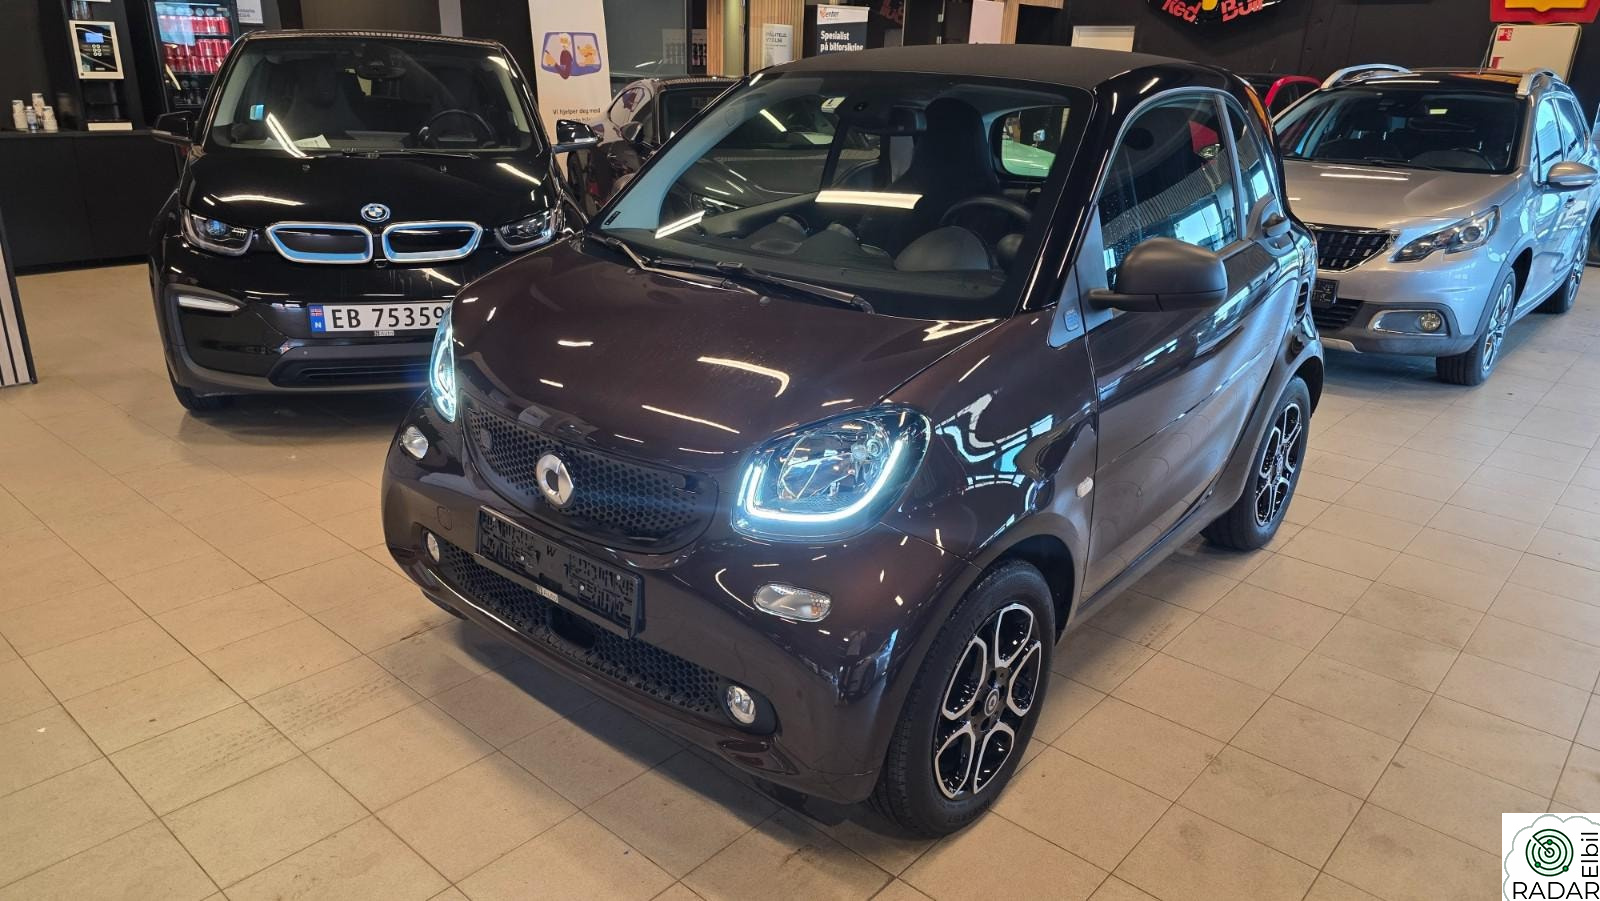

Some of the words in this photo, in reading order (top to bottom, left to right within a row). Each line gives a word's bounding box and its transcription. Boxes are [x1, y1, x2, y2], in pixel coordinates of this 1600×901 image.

[820, 30, 850, 41] Spesialist
[820, 41, 829, 52] på
[559, 108, 578, 116] hjelper
[331, 309, 361, 329] EB
[314, 321, 322, 329] N
